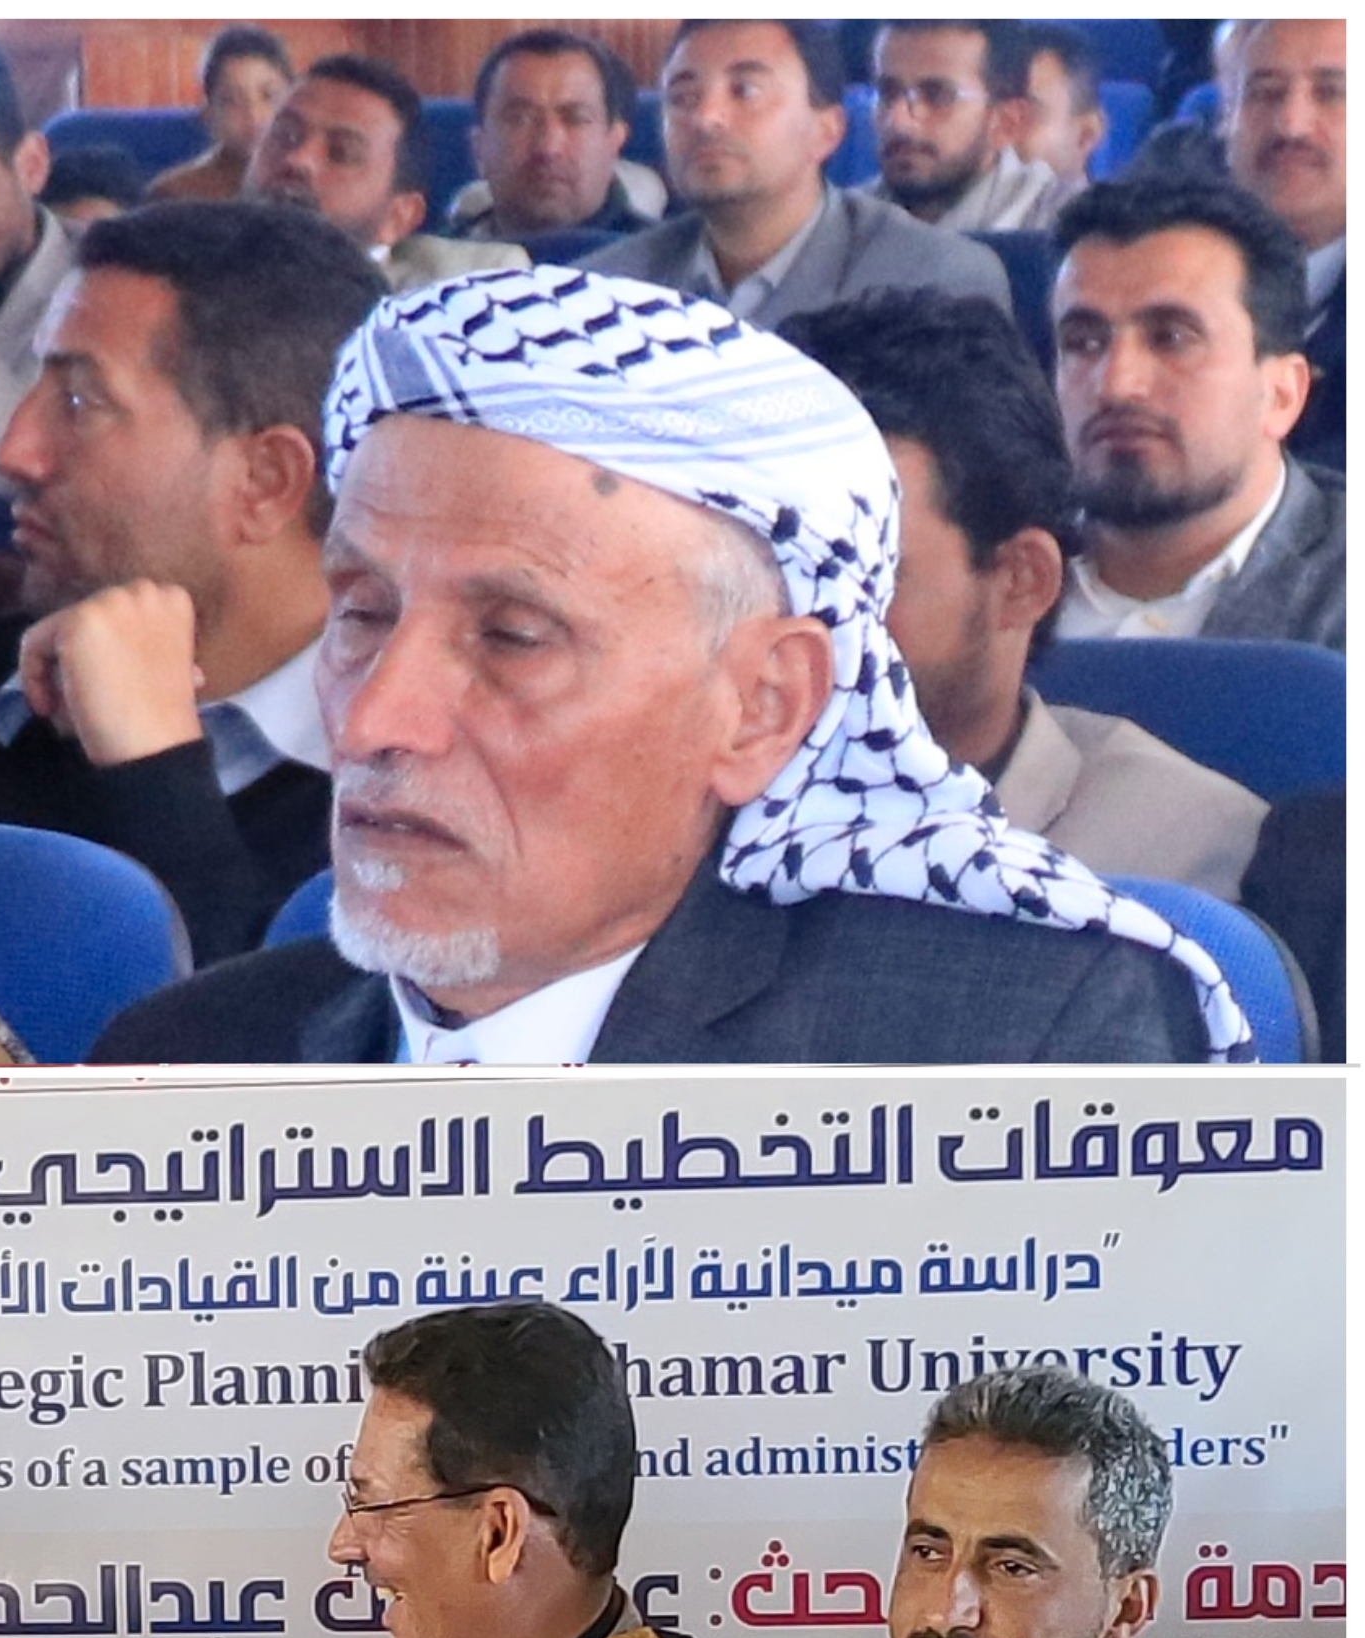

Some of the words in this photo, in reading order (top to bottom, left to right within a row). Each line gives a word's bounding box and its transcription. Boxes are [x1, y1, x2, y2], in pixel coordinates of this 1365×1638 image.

[511, 1102, 914, 1211] التخطيط
[938, 1098, 1324, 1195] معوقات
[60, 1254, 299, 1323] القيادات
[312, 1257, 401, 1315] من
[689, 1247, 904, 1310] ميدانية
[143, 1348, 367, 1407] Planni
[614, 1342, 846, 1399] hamar
[27, 1447, 75, 1489] of
[82, 1457, 109, 1488] a
[120, 1445, 291, 1495] sample
[636, 1436, 690, 1478] nd
[705, 1433, 922, 1477] administ
[1169, 1424, 1289, 1468] ders"
